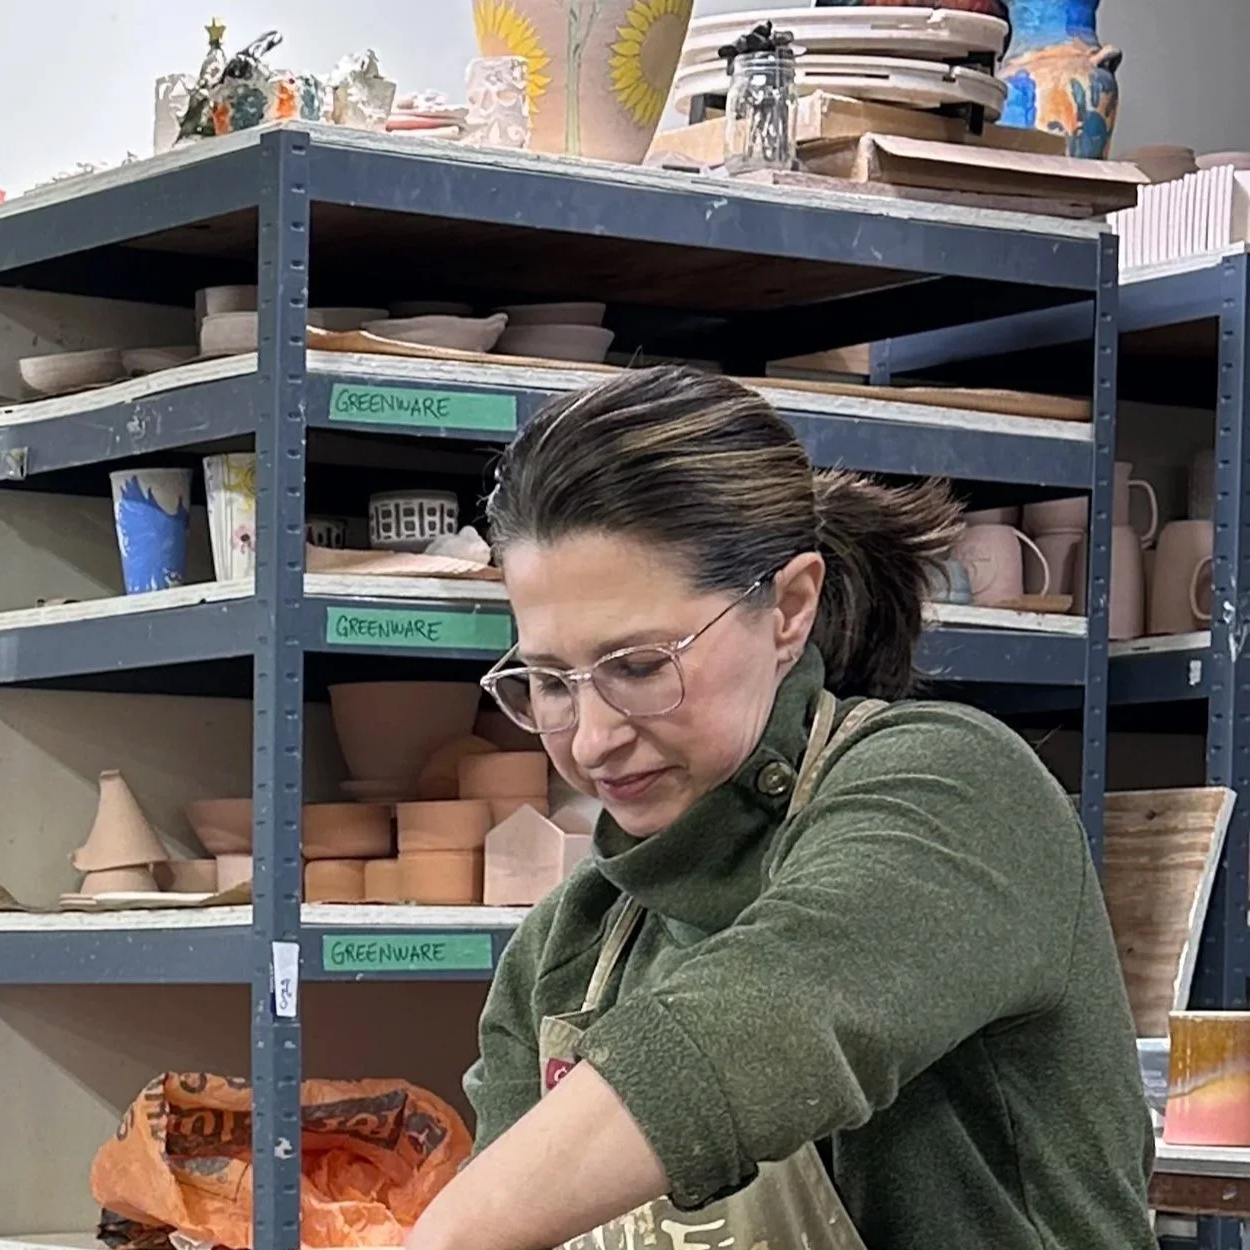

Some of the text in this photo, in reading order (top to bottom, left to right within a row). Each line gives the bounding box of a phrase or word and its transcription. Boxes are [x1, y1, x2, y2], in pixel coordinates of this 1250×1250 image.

[334, 388, 450, 419] GREENWARE
[335, 614, 443, 642] GREENWARE
[331, 941, 447, 966] GREENWARE
